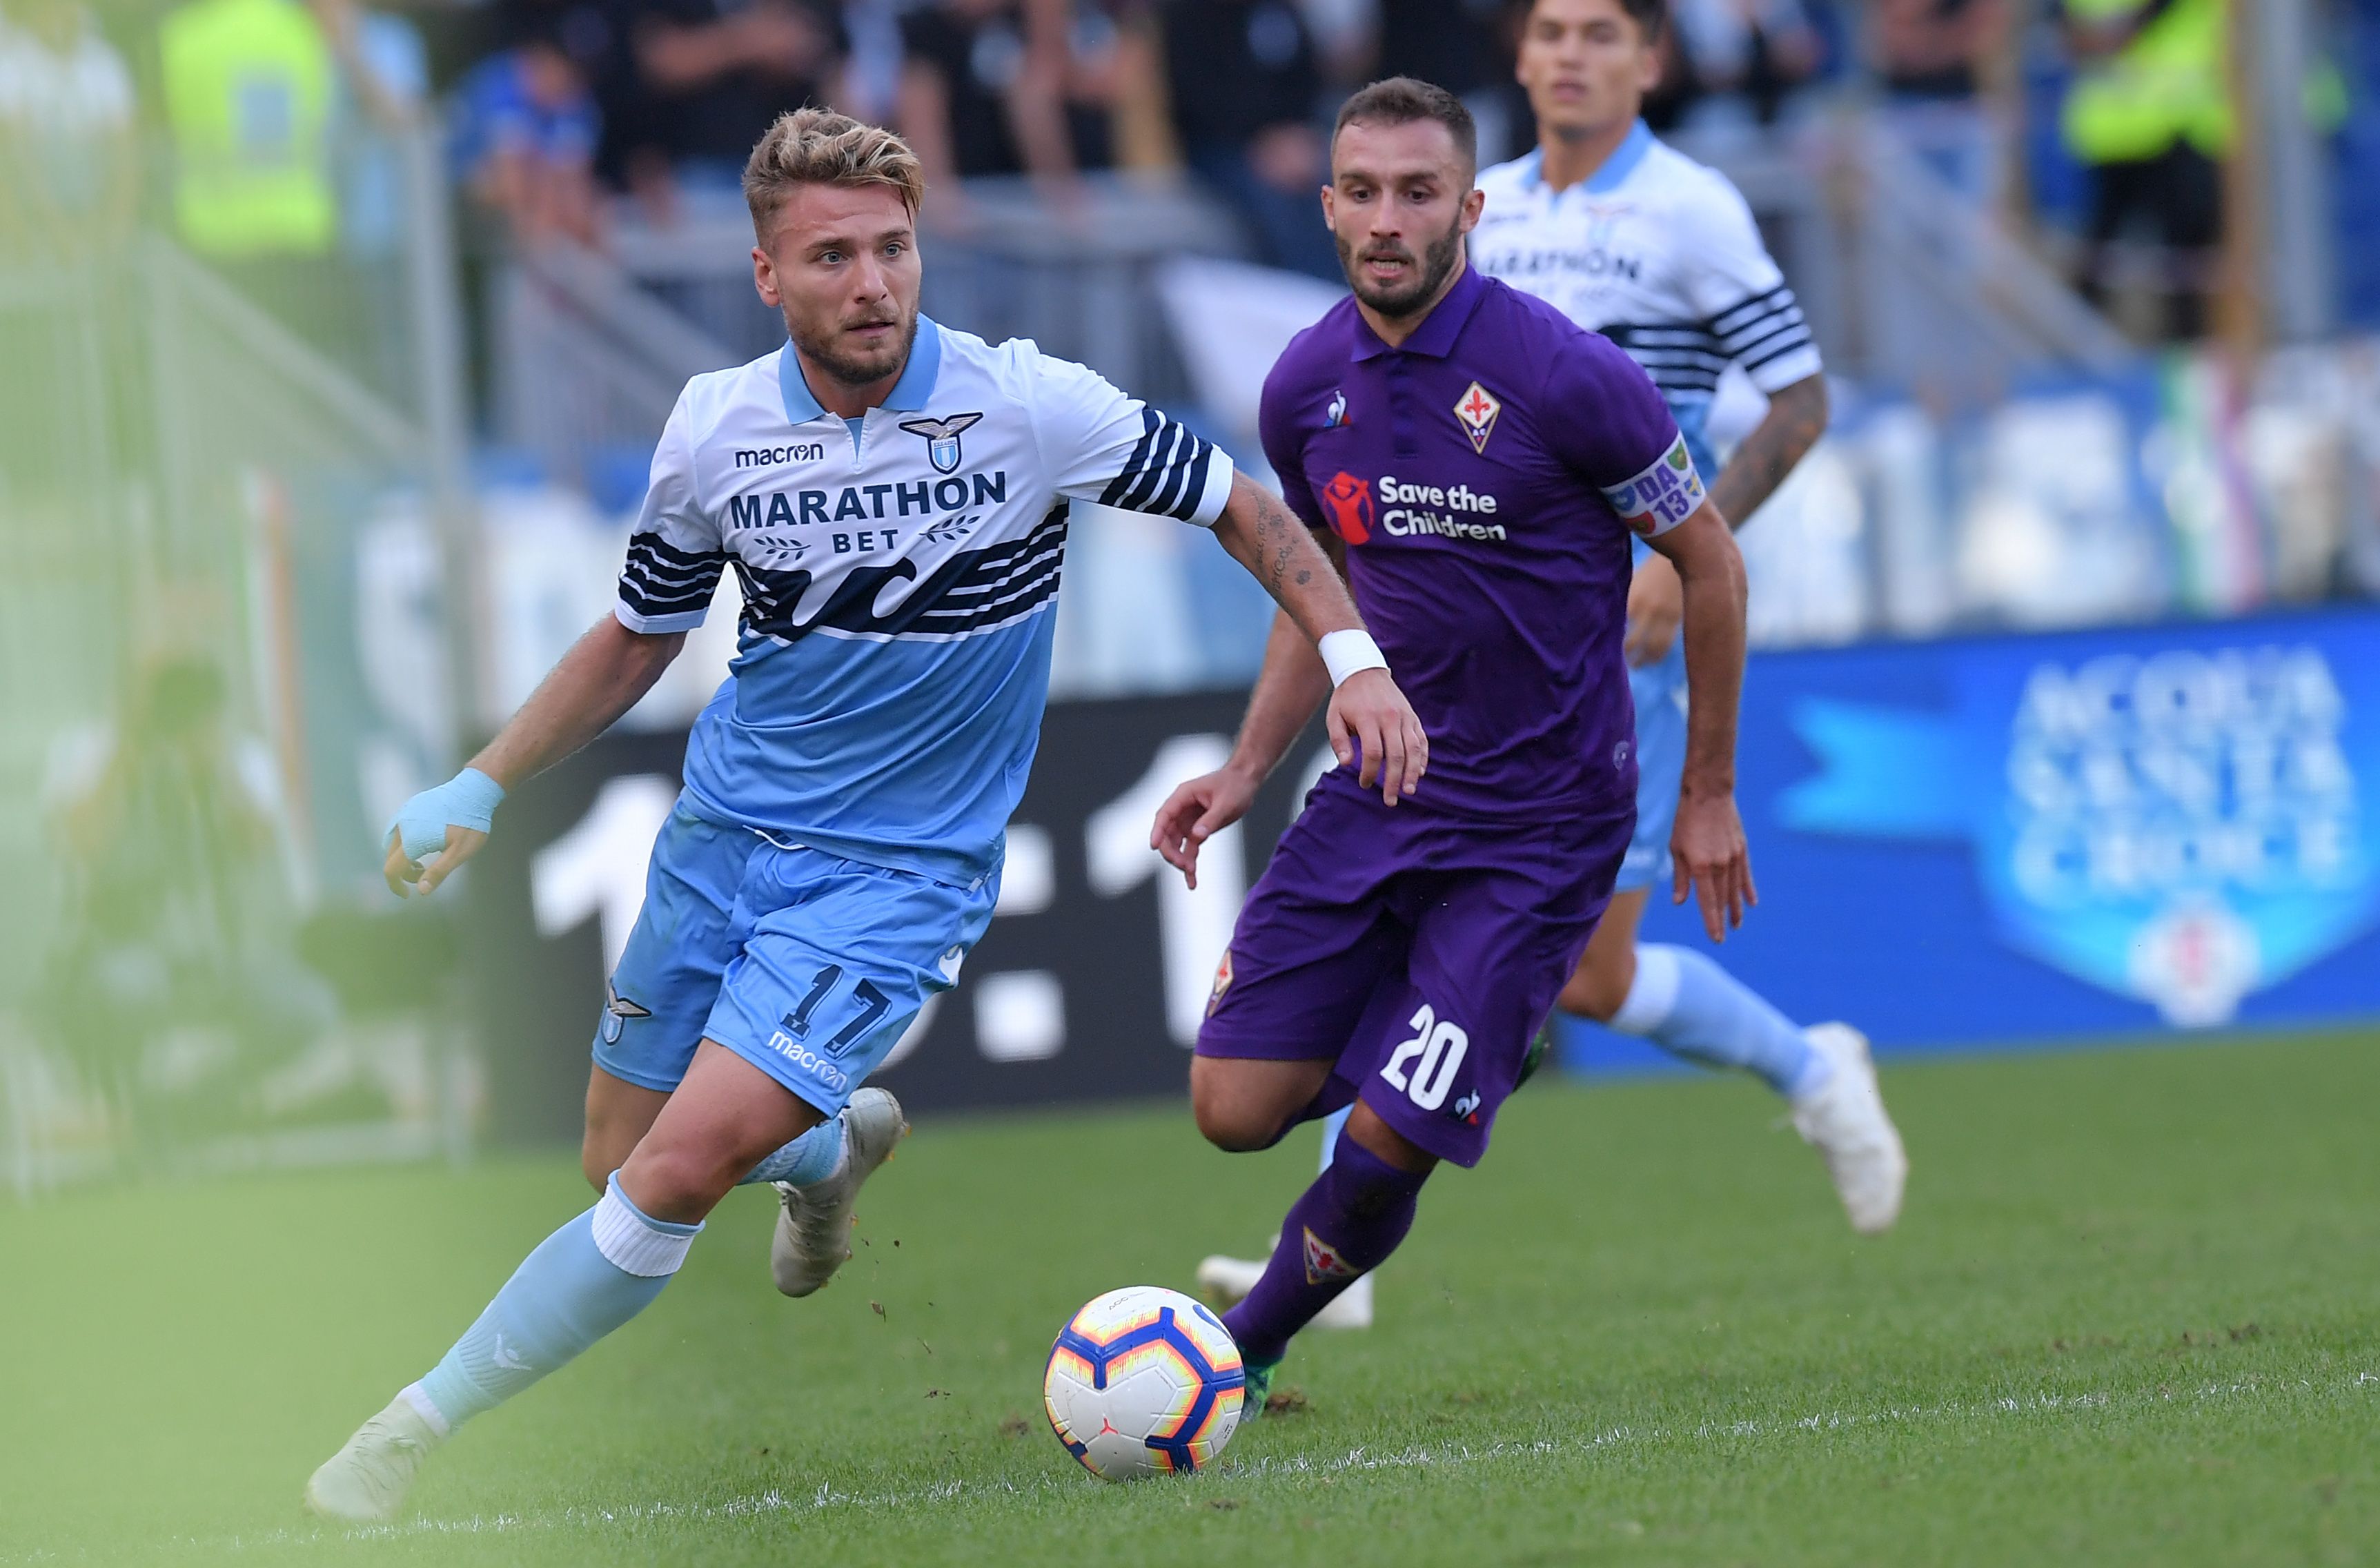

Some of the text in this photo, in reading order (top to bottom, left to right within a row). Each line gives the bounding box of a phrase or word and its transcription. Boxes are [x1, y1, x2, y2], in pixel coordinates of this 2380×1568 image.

[735, 443, 824, 468] macron
[730, 471, 1007, 529] MARATHON
[1378, 476, 1497, 514] Save the
[1634, 463, 1679, 510] DA
[1653, 489, 1689, 523] 13
[832, 529, 899, 553] BET
[1382, 509, 1507, 541] Children
[780, 963, 893, 1059] 17
[767, 1030, 847, 1093] macron
[1379, 1003, 1469, 1111] 20
